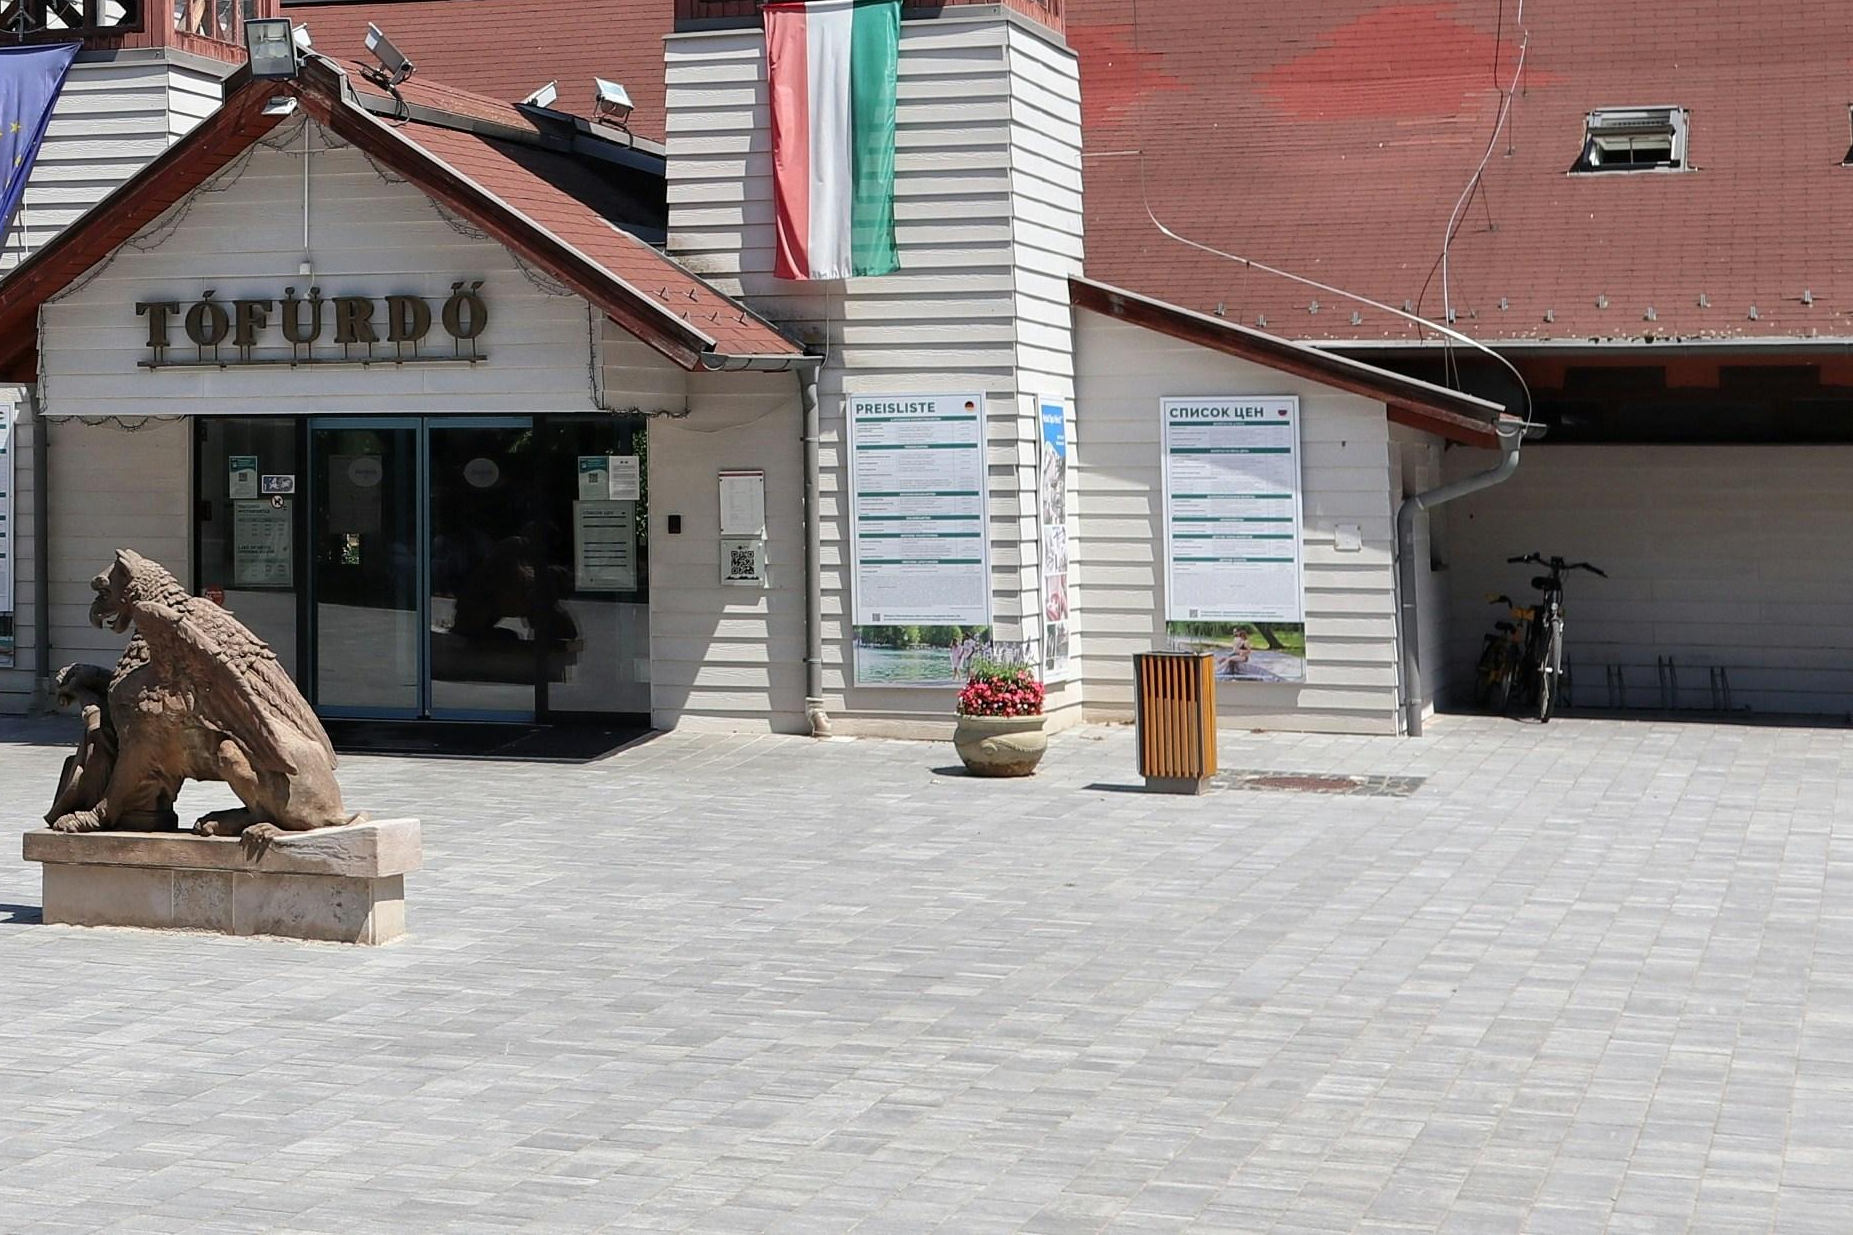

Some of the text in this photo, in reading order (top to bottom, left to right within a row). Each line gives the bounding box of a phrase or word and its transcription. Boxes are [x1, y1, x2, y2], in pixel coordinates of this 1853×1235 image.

[135, 281, 488, 348] TÓFÜRDŐ
[856, 402, 936, 414] PREISLISTE
[1170, 406, 1264, 419] СПИСОК ЦЕН
